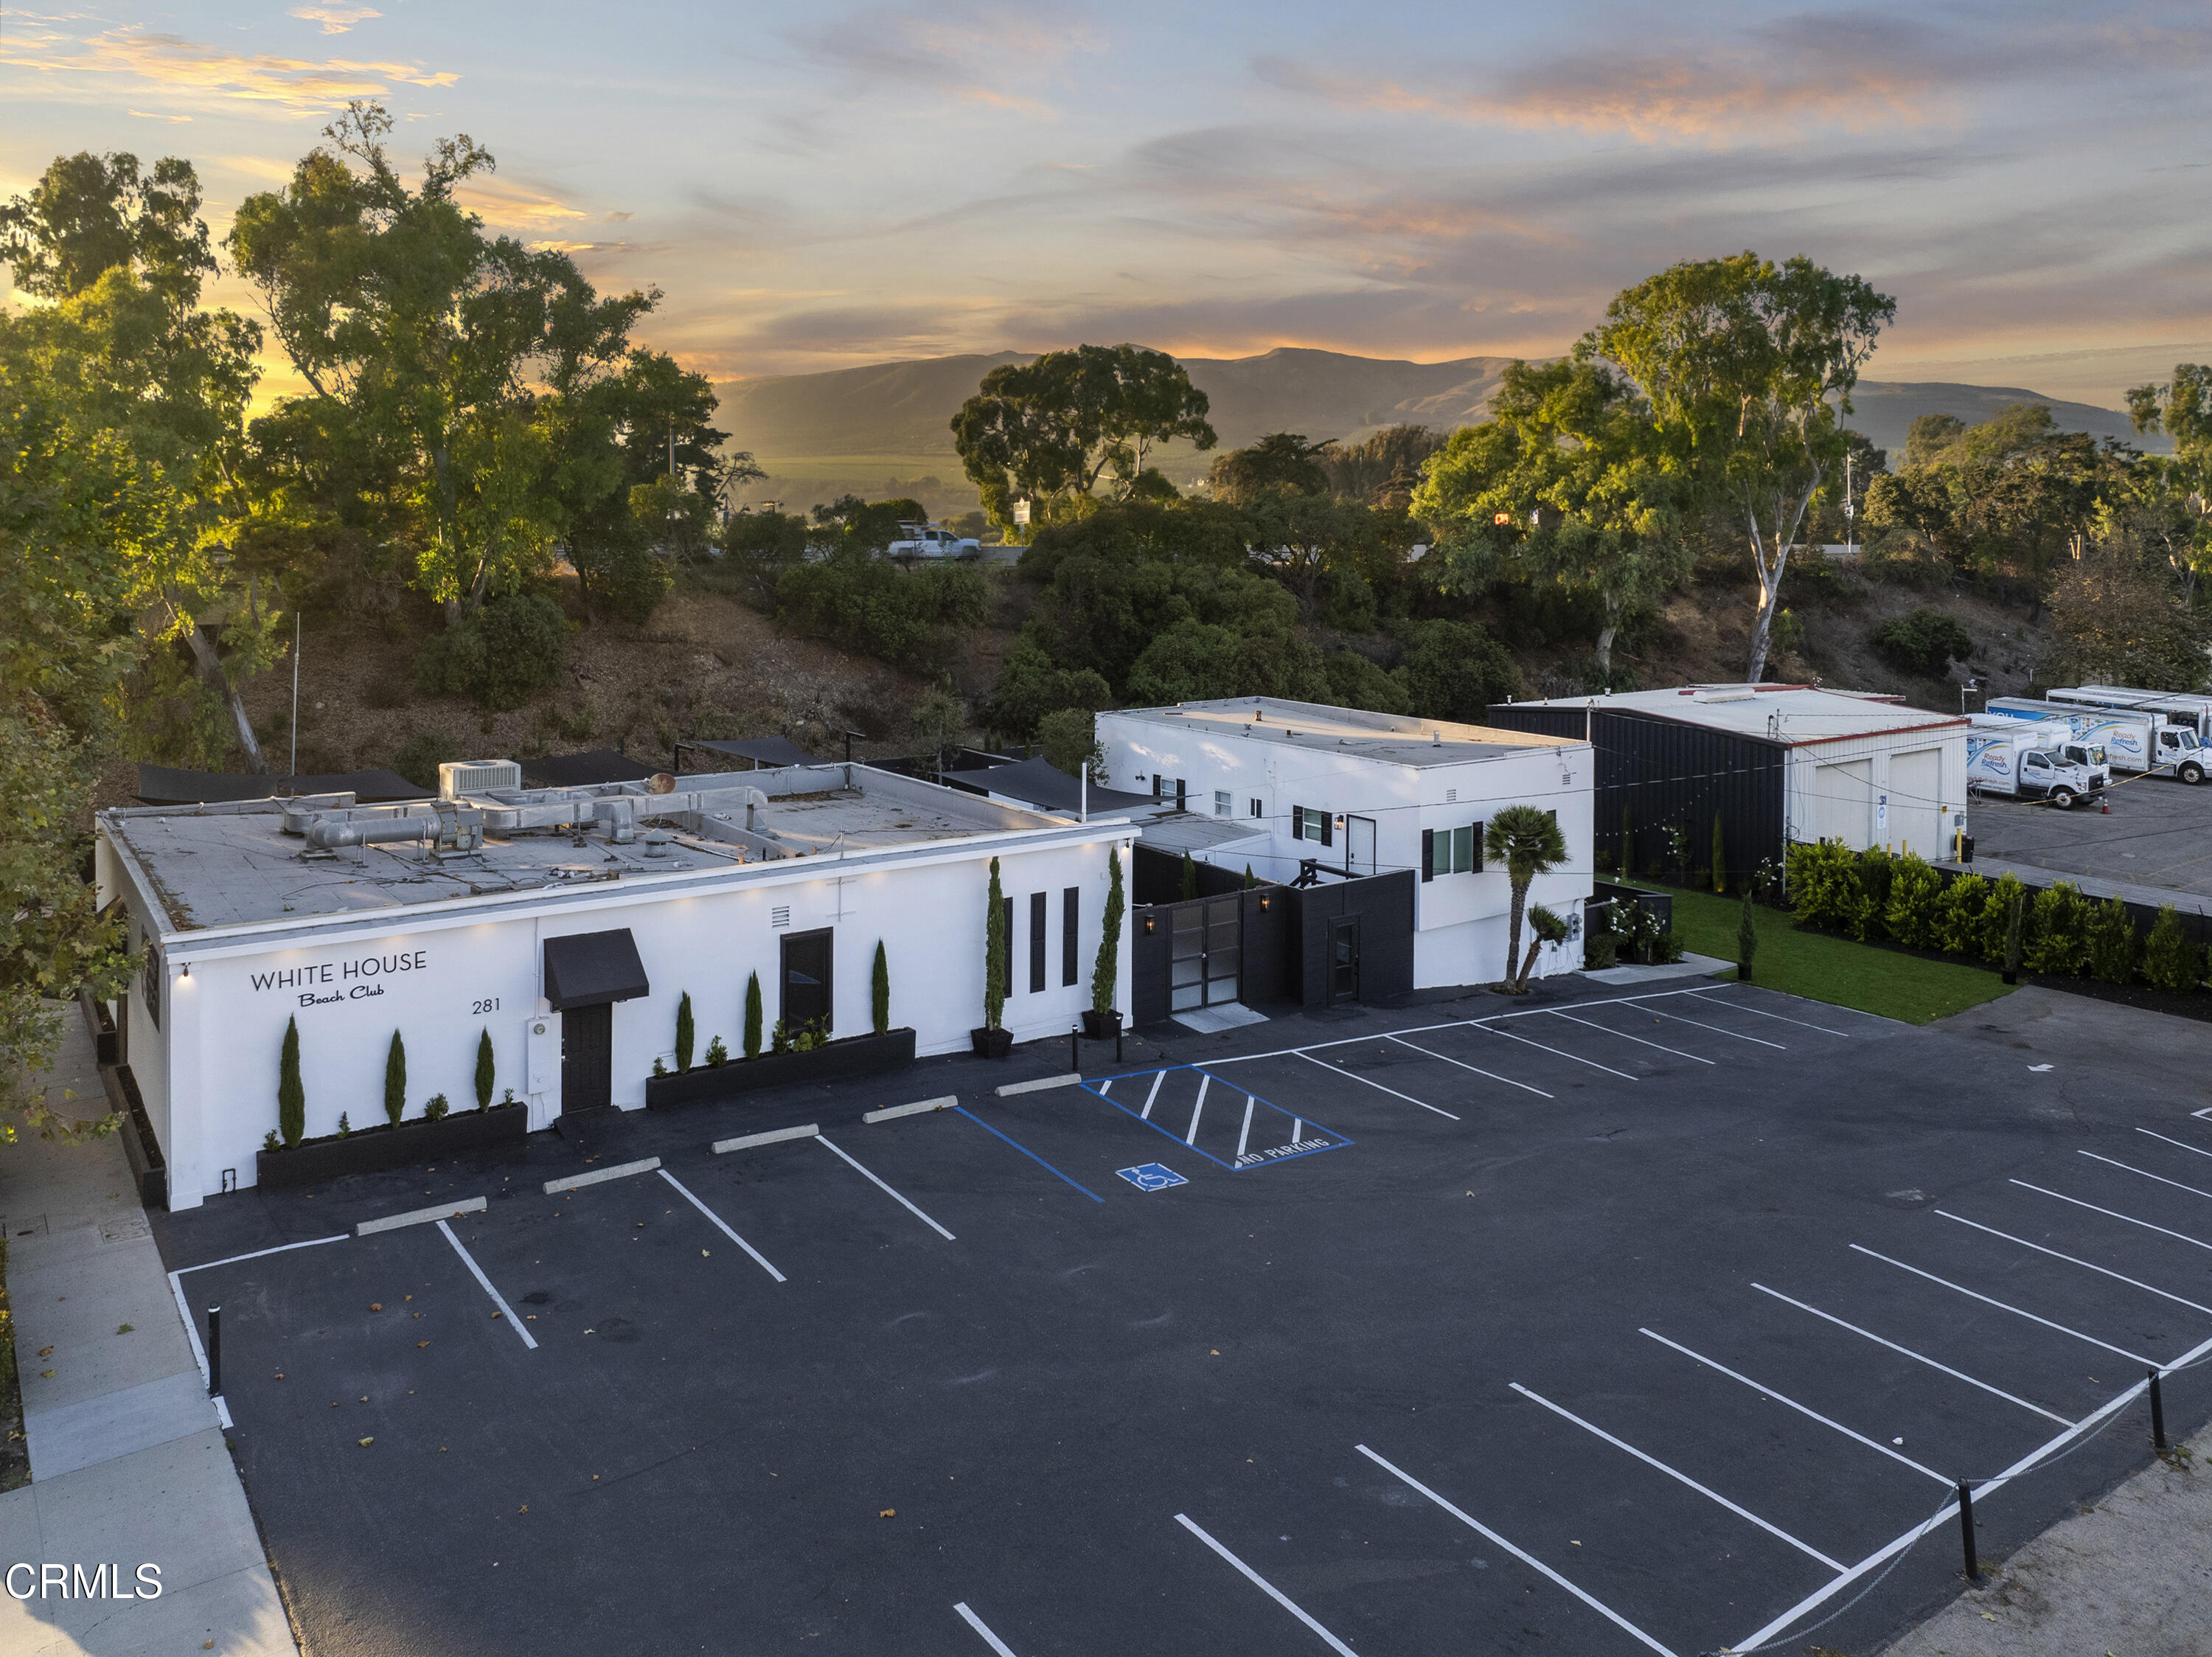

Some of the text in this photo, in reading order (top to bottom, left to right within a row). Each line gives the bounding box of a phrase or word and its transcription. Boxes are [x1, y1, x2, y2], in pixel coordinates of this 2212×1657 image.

[2110, 737, 2138, 746] Refresh
[2113, 731, 2136, 740] Ready
[1981, 759, 2007, 768] Refresh
[1984, 753, 2006, 763] Ready
[251, 951, 427, 992] WHITE HOUSE
[297, 984, 385, 1007] Beach Club
[472, 998, 501, 1015] 281
[1237, 1138, 1330, 1165] NO PARKING
